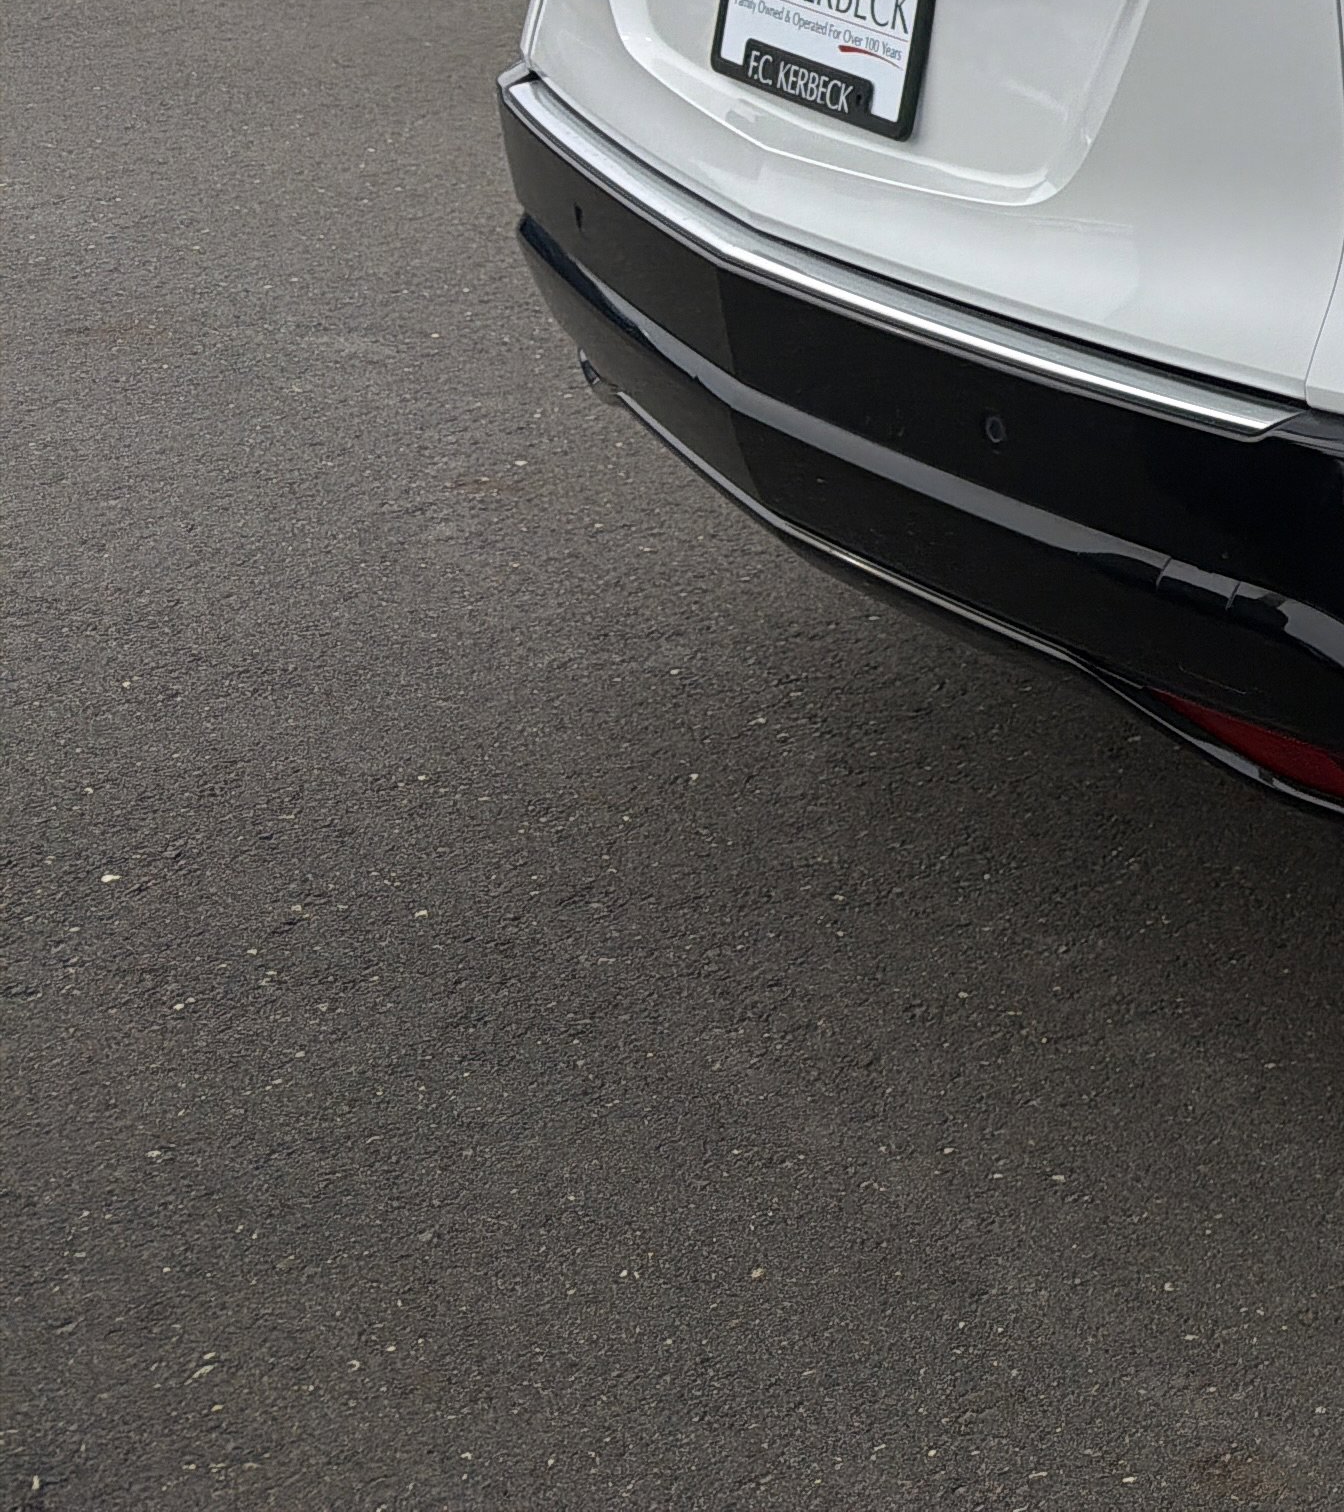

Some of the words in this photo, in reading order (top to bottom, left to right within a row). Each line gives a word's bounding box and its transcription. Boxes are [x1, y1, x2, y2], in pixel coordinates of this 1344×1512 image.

[758, 0, 785, 20] Owned
[784, 10, 791, 24] &
[792, 12, 829, 36] Operated
[828, 23, 842, 39] For
[842, 29, 863, 46] Over
[865, 36, 880, 53] 100
[882, 41, 903, 61] Years
[747, 50, 773, 86] F.C.
[776, 61, 854, 114] KERBECK
